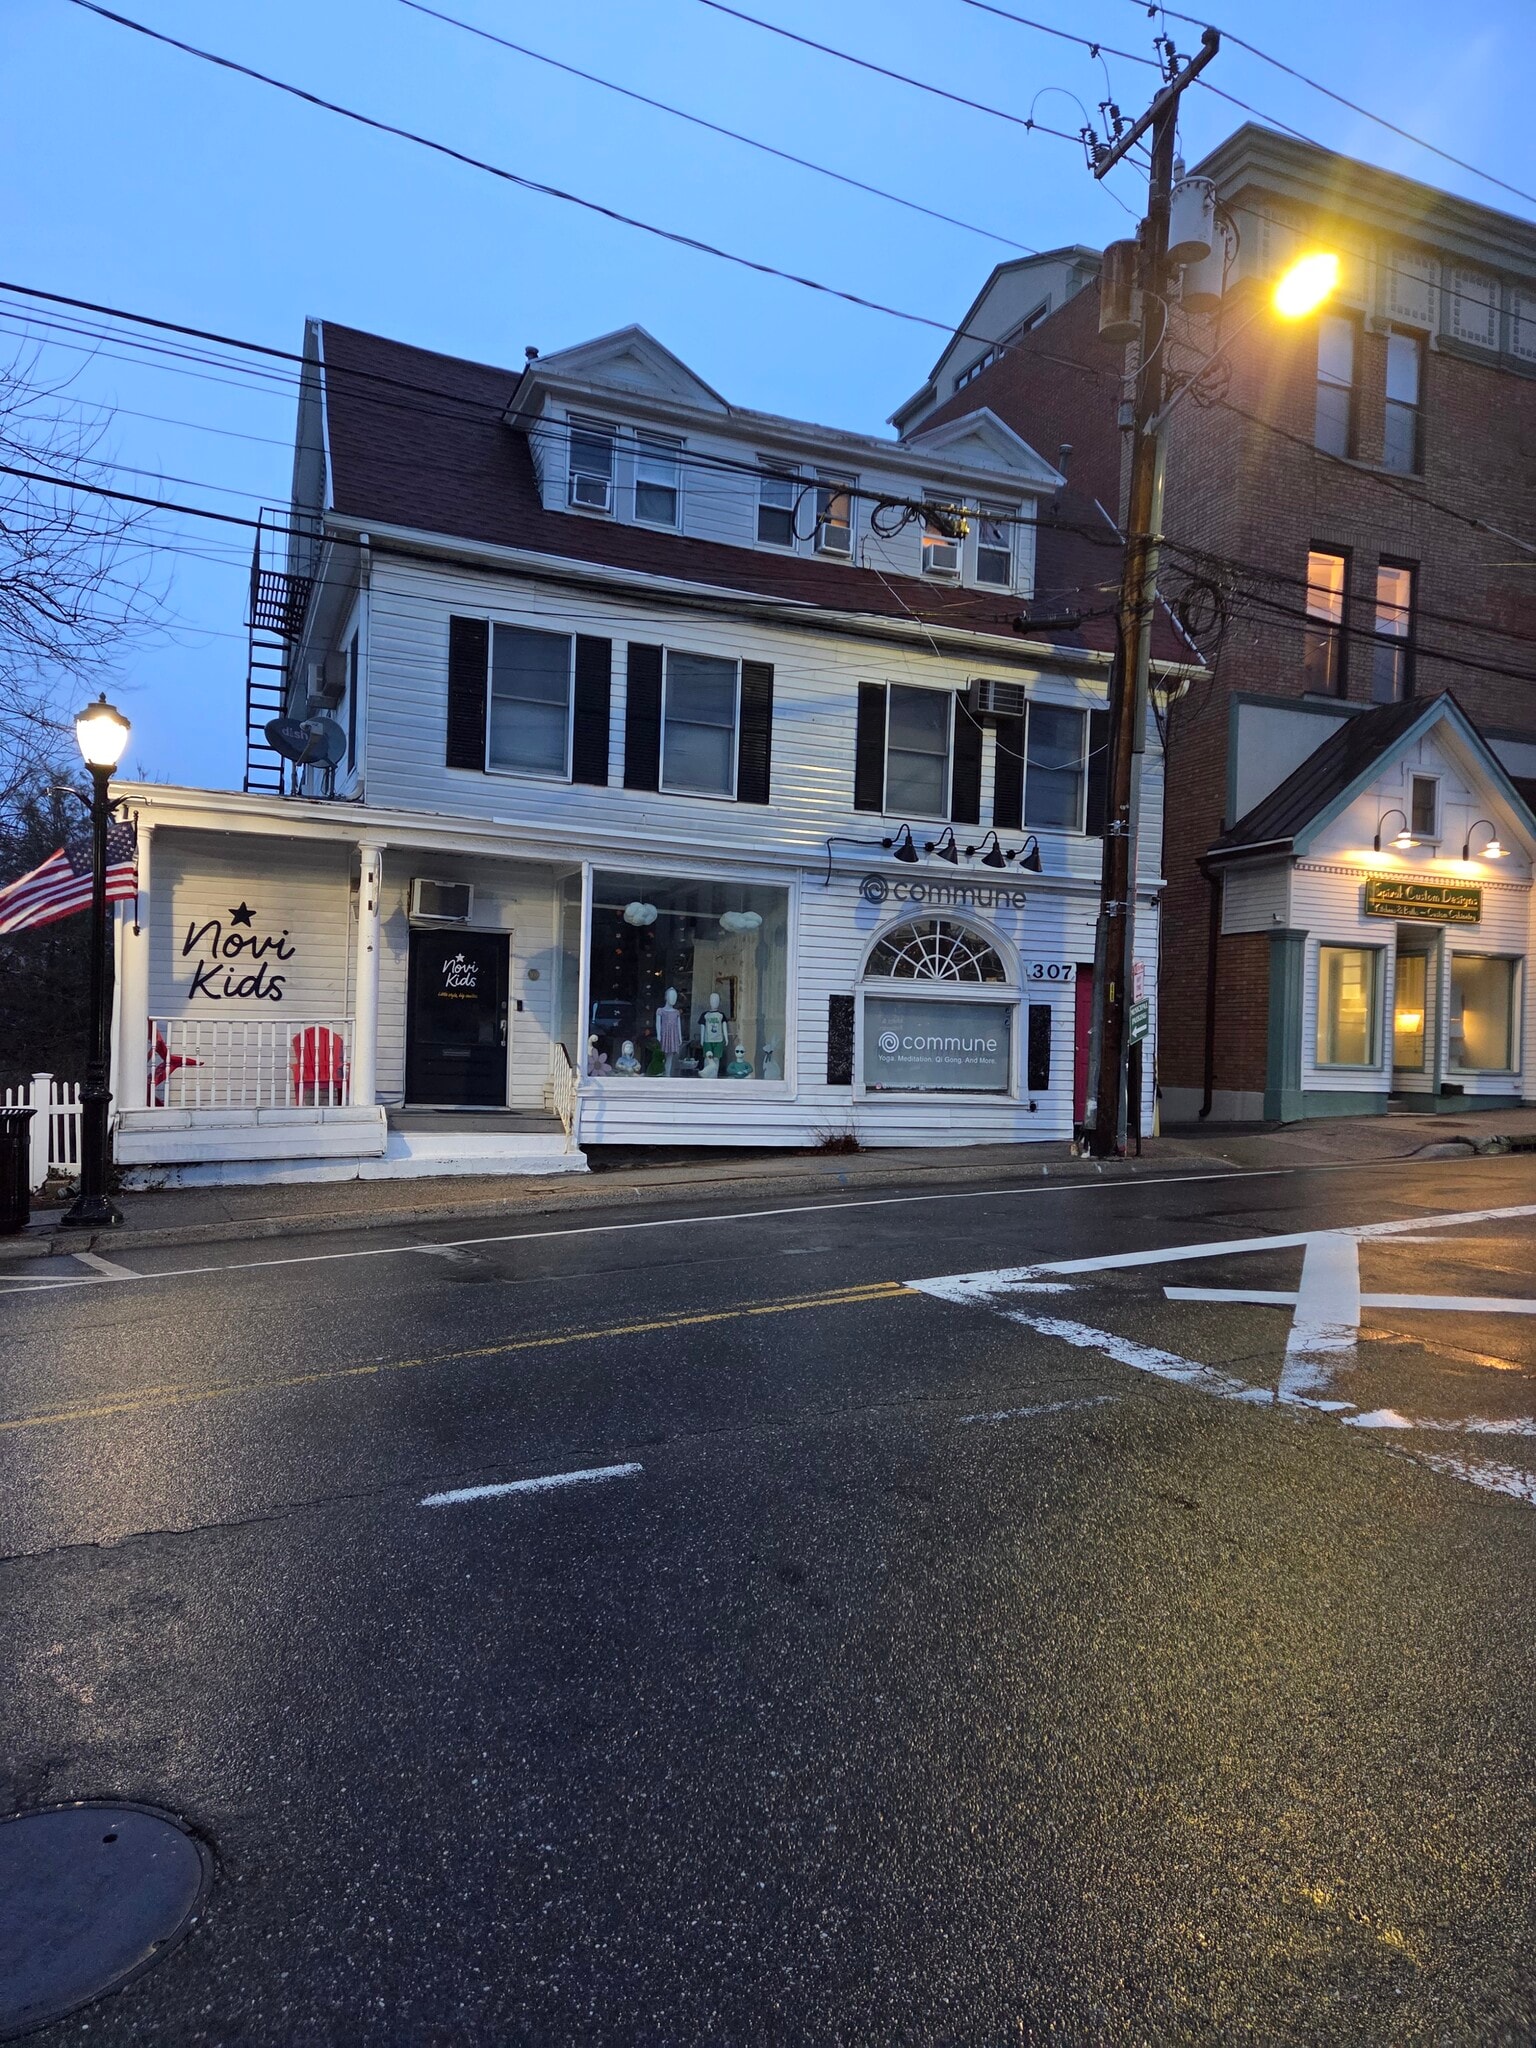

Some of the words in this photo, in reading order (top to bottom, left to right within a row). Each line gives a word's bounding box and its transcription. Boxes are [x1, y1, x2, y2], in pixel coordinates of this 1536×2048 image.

[281, 727, 309, 740] dish
[894, 882, 1027, 909] commune
[1406, 885, 1440, 902] Custom
[1442, 888, 1478, 907] Designs
[182, 920, 296, 960] Novi
[442, 959, 479, 974] Novi
[1033, 964, 1072, 980] 307
[188, 959, 286, 1001] Kids
[445, 972, 477, 988] Kids
[902, 1036, 998, 1052] commune
[965, 1056, 978, 1064] And
